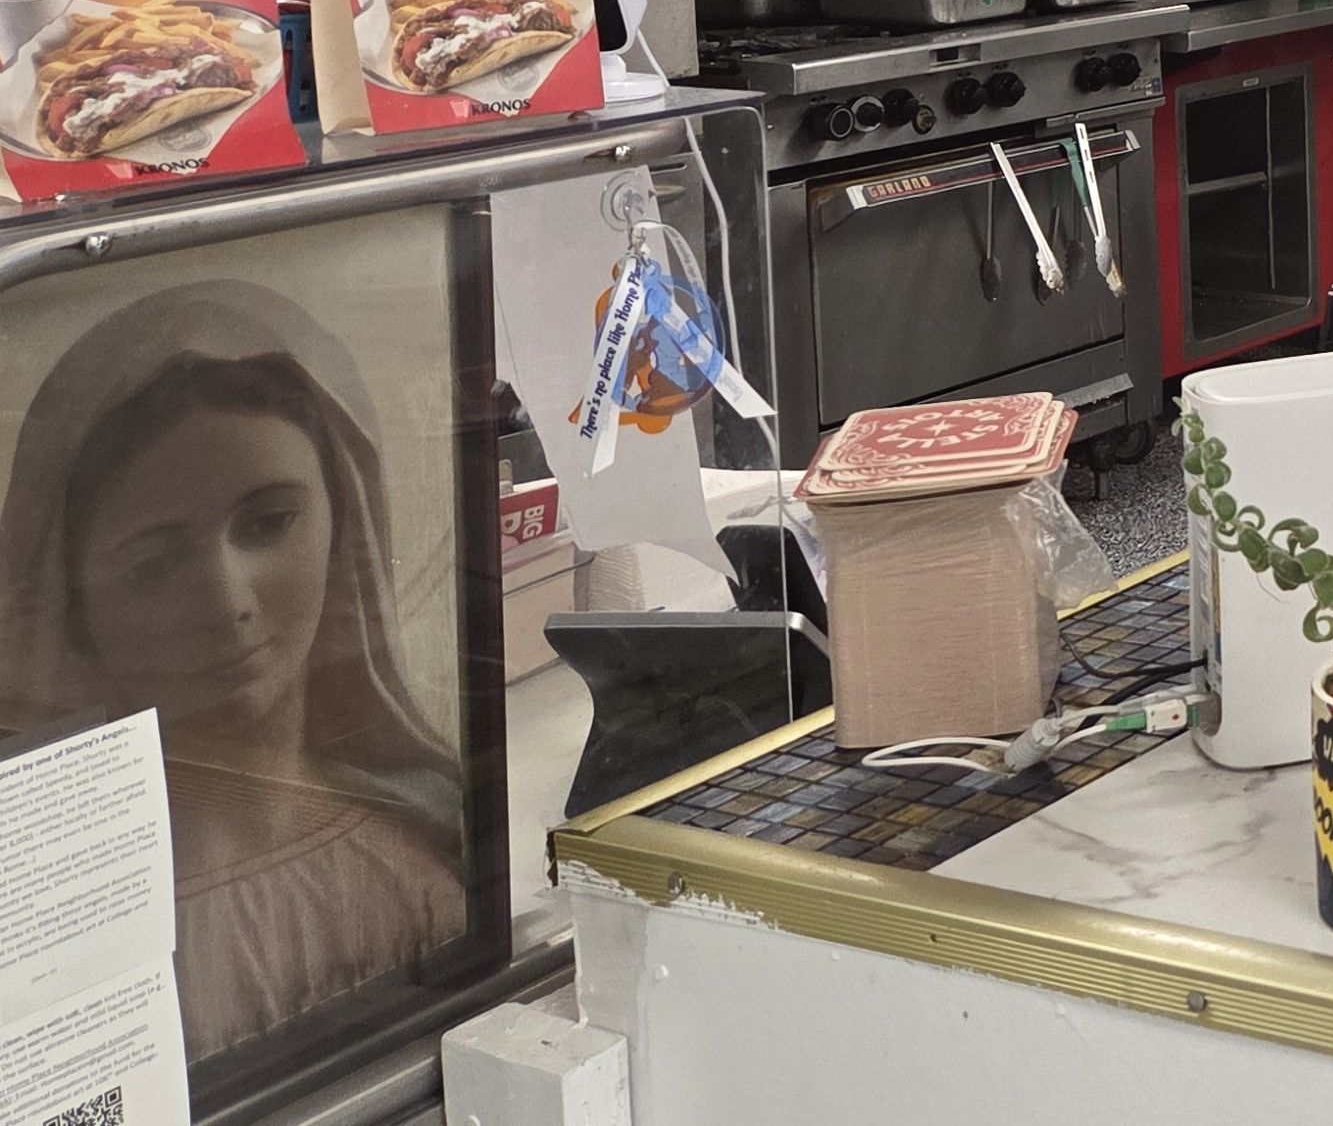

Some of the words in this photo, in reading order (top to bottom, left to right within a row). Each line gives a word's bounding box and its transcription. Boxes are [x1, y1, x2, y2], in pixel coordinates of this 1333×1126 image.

[471, 98, 531, 116] KRONOS
[135, 158, 210, 176] KRONOS
[867, 175, 932, 198] GARLAND
[614, 285, 640, 321] Home
[607, 323, 625, 346] like
[599, 345, 617, 382] place
[595, 378, 606, 397] no
[579, 396, 603, 441] There's
[881, 410, 1005, 433] ARTOIS
[877, 423, 999, 449] STELLA
[522, 505, 544, 538] BIG
[64, 737, 99, 755] Shorty's
